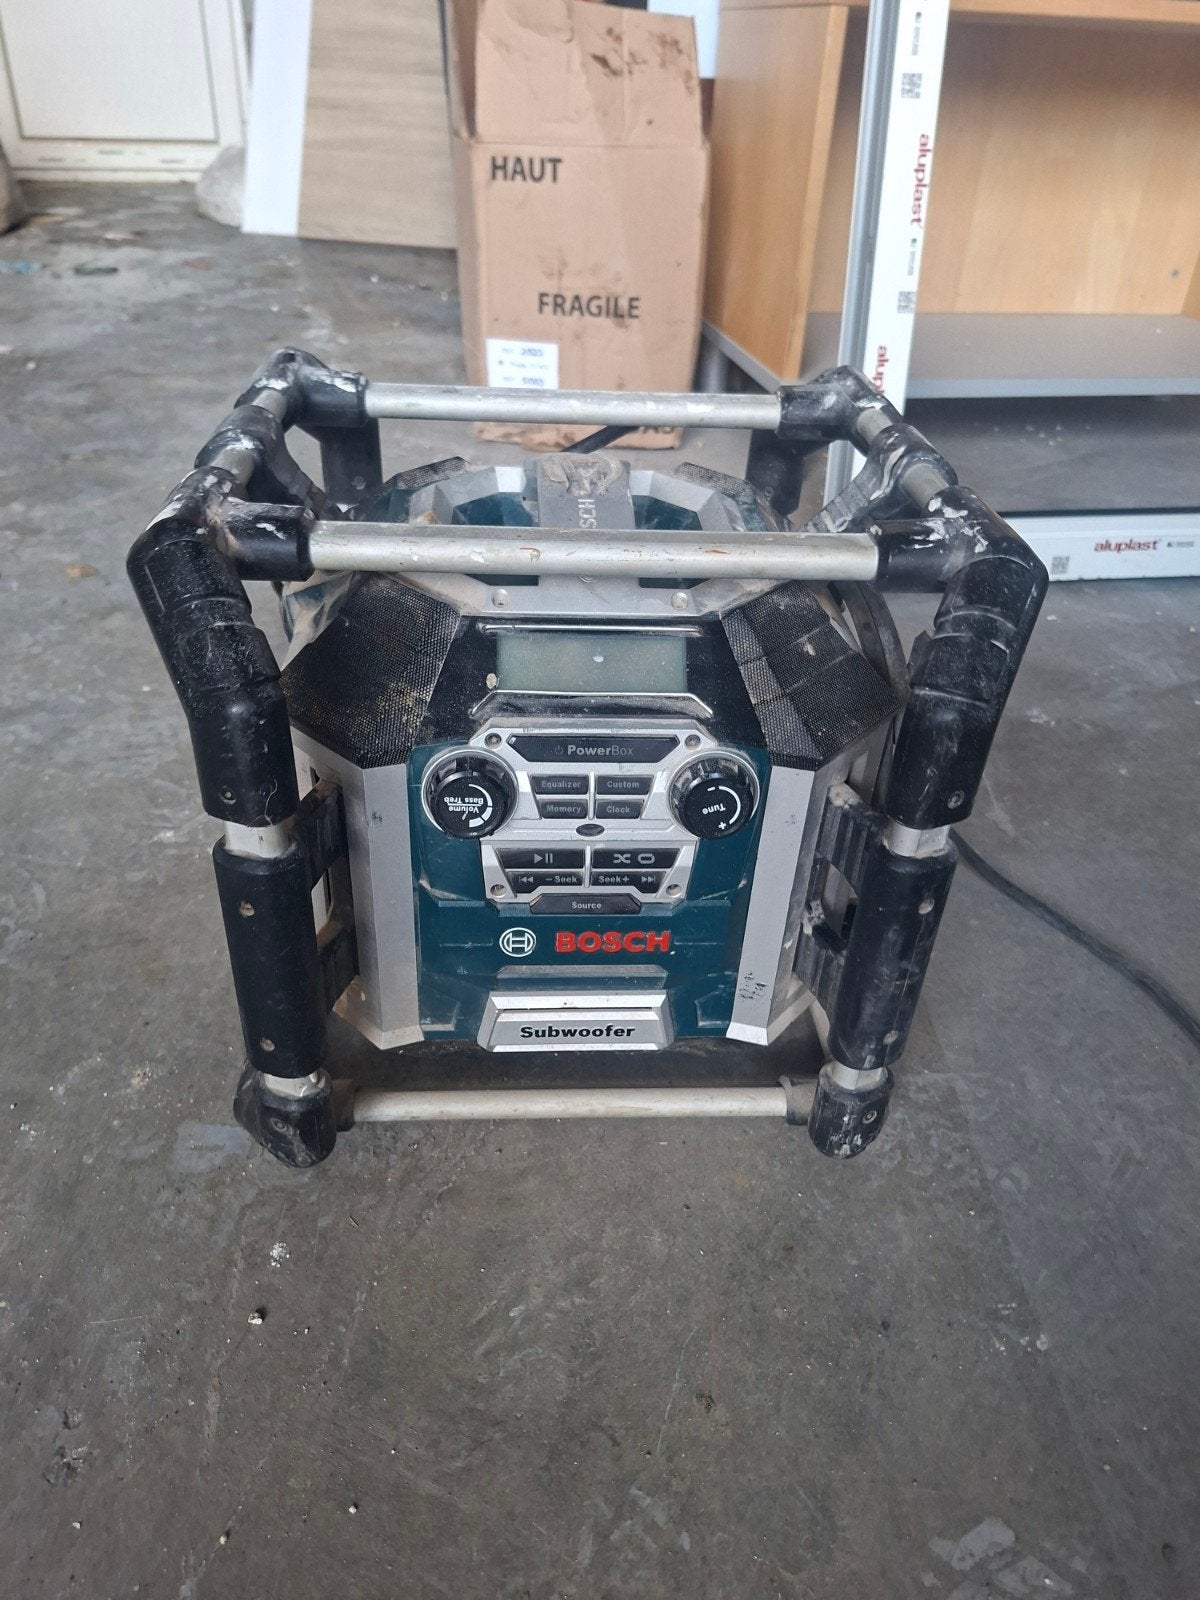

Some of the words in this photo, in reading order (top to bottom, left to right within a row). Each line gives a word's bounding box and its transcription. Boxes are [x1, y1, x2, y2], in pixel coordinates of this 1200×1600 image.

[490, 156, 563, 184] HAUT
[911, 133, 931, 227] aluplast
[537, 292, 642, 320] FRAGILE
[872, 345, 889, 394] alupl
[577, 498, 597, 529] SCH
[1094, 538, 1160, 553] aluplast
[567, 744, 634, 756] PowerBox
[541, 780, 581, 789] Equalizer
[606, 780, 640, 789] Custom
[443, 796, 463, 804] Treb
[465, 797, 484, 805] Bass
[448, 806, 479, 814] Volume
[546, 804, 582, 814] Memory
[606, 805, 631, 813] Clock
[702, 802, 727, 815] Tune
[571, 901, 602, 910] Source
[555, 930, 671, 953] BOSCH
[520, 1024, 636, 1039] Subwoofer
